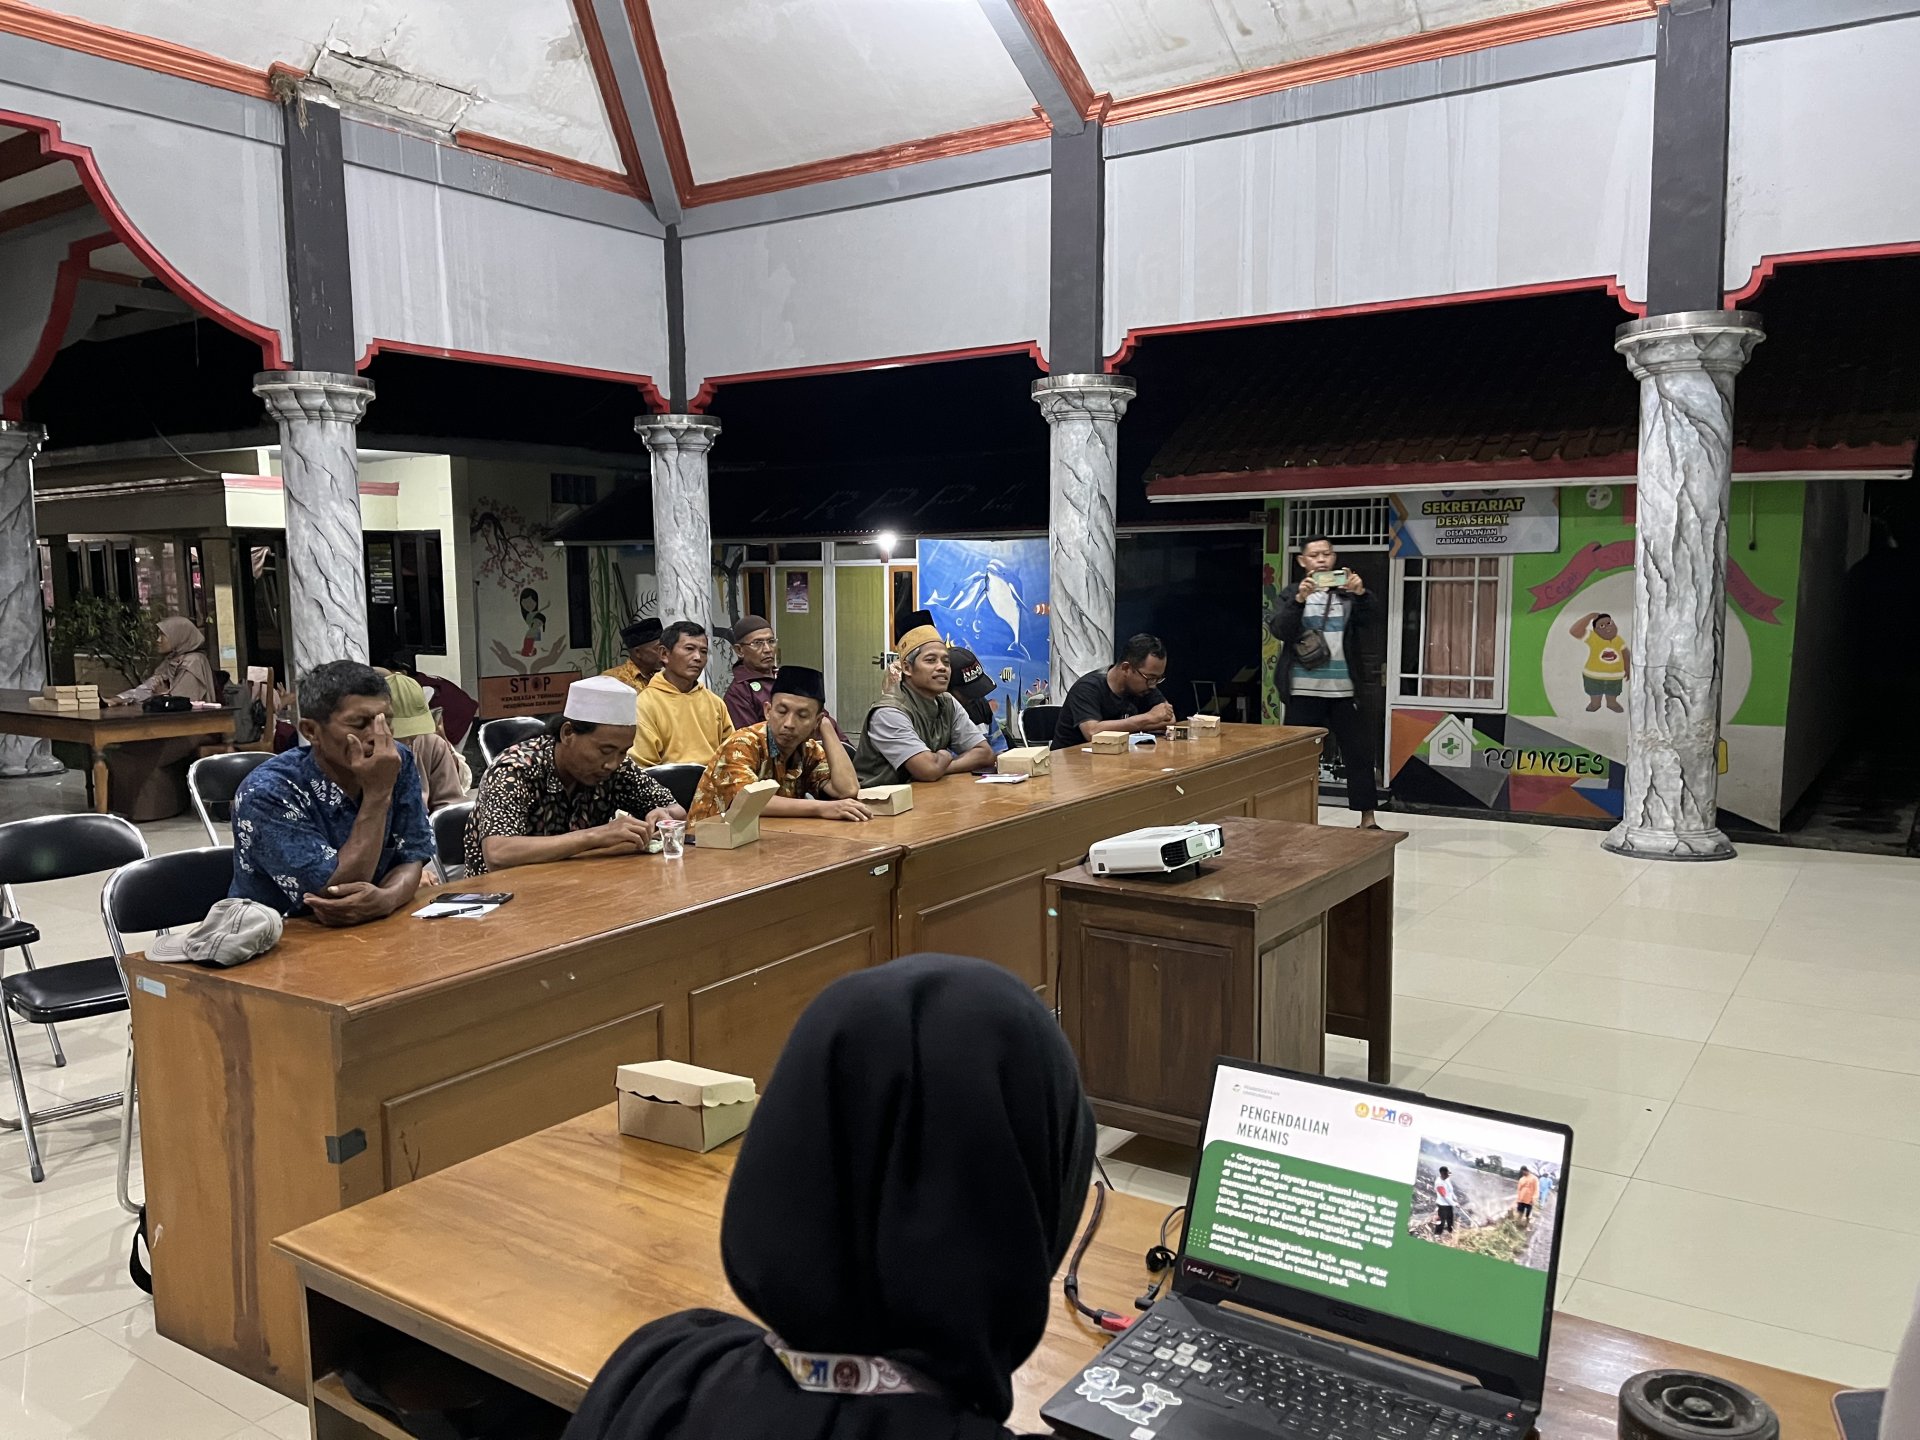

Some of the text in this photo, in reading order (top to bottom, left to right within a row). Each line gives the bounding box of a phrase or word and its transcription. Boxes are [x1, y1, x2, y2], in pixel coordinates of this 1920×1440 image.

[1422, 498, 1524, 515] SEKRETARIAT
[1437, 515, 1508, 526] DESA SEHAT
[1446, 528, 1498, 537] DESA PLANJAN
[1436, 536, 1507, 545] KABUPATEN CILACAP
[1240, 1104, 1330, 1136] PENGENDALIAN
[1236, 1122, 1289, 1146] MEKANIS
[1352, 1190, 1376, 1202] hama
